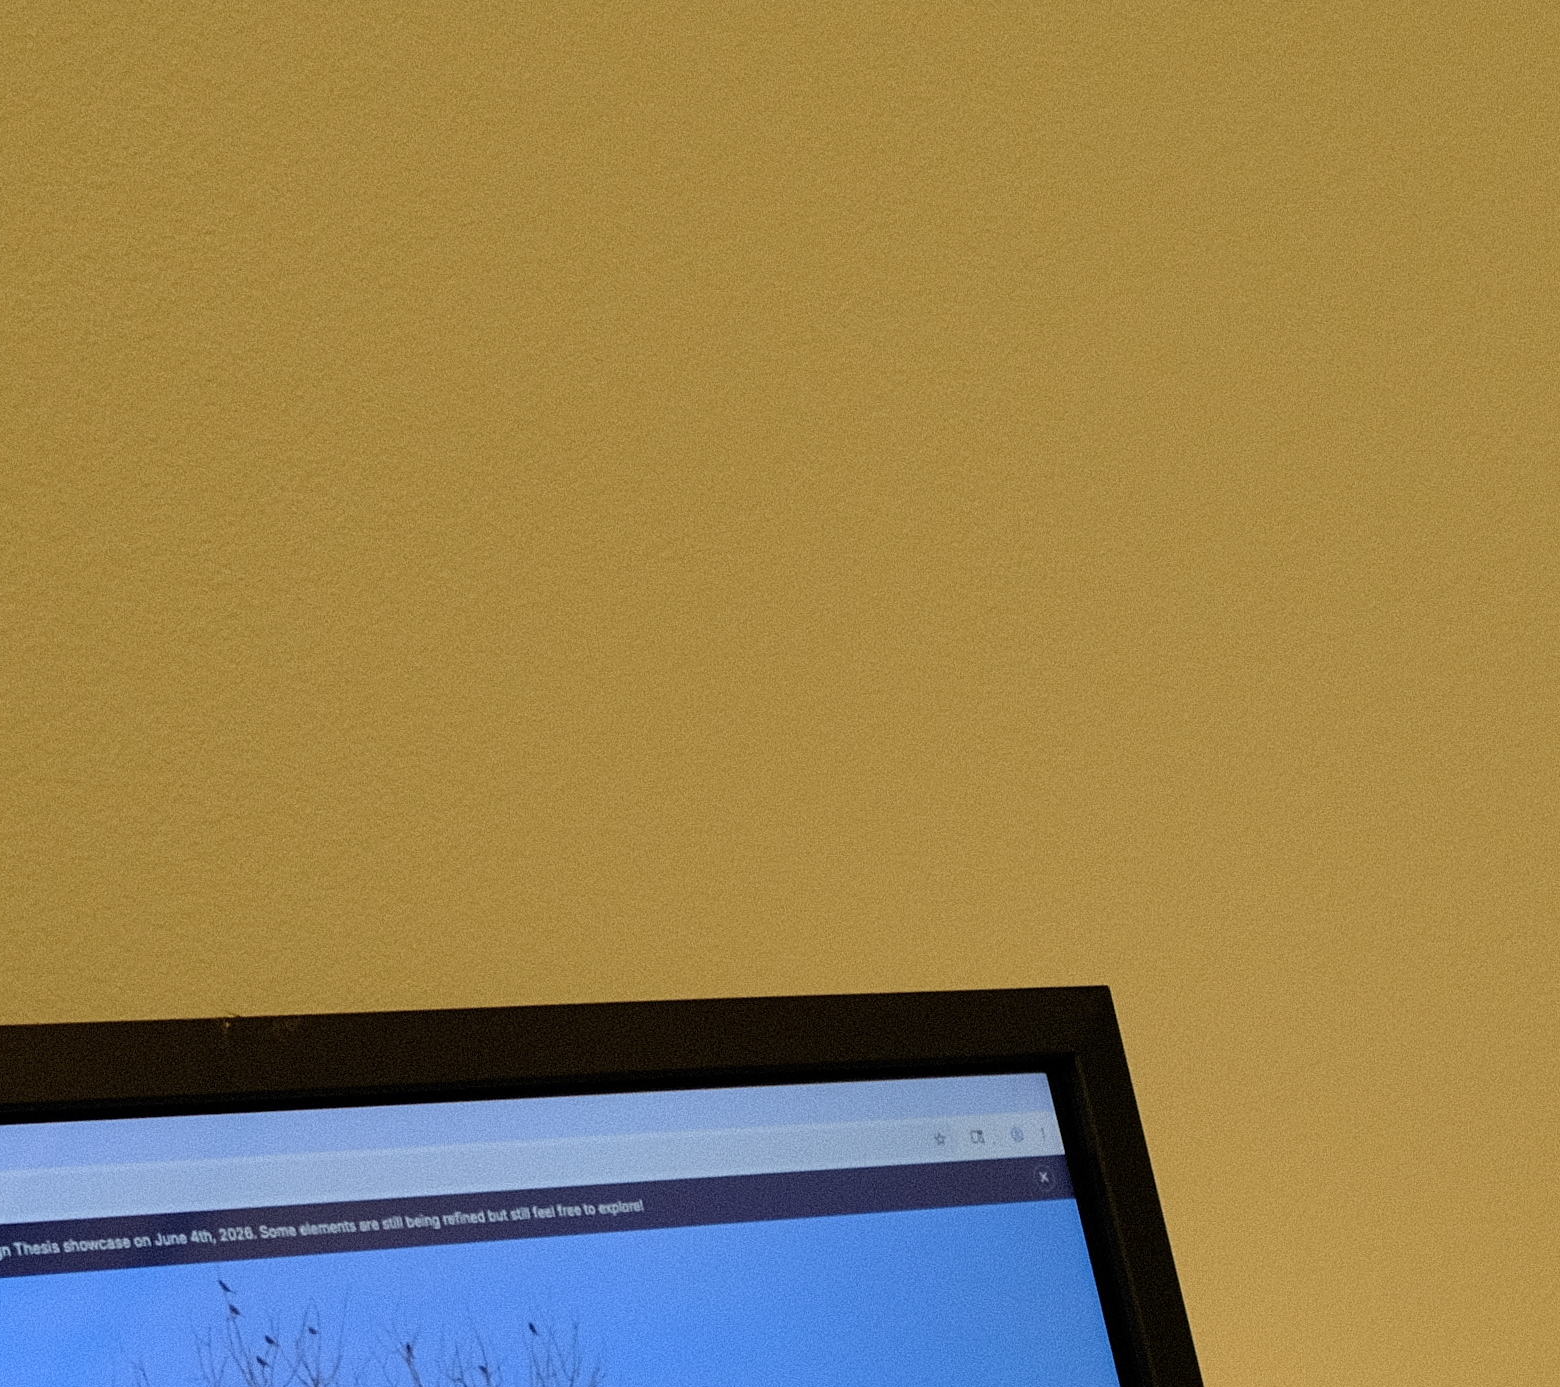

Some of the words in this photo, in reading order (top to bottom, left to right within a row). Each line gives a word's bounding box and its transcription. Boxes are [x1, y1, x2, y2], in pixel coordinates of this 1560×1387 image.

[14, 1238, 60, 1256] Thesis
[63, 1234, 131, 1253] showcase
[134, 1234, 151, 1248] on
[154, 1230, 188, 1247] June
[191, 1228, 216, 1245] 4th,
[260, 1223, 297, 1240] Some
[300, 1218, 356, 1236] elements
[359, 1217, 380, 1232] are
[382, 1215, 403, 1230] still
[406, 1211, 441, 1230] being
[443, 1208, 485, 1226] refined
[488, 1207, 508, 1222] but
[510, 1205, 531, 1221] still
[533, 1204, 555, 1219] feel
[558, 1202, 582, 1218] free
[584, 1202, 596, 1216] to
